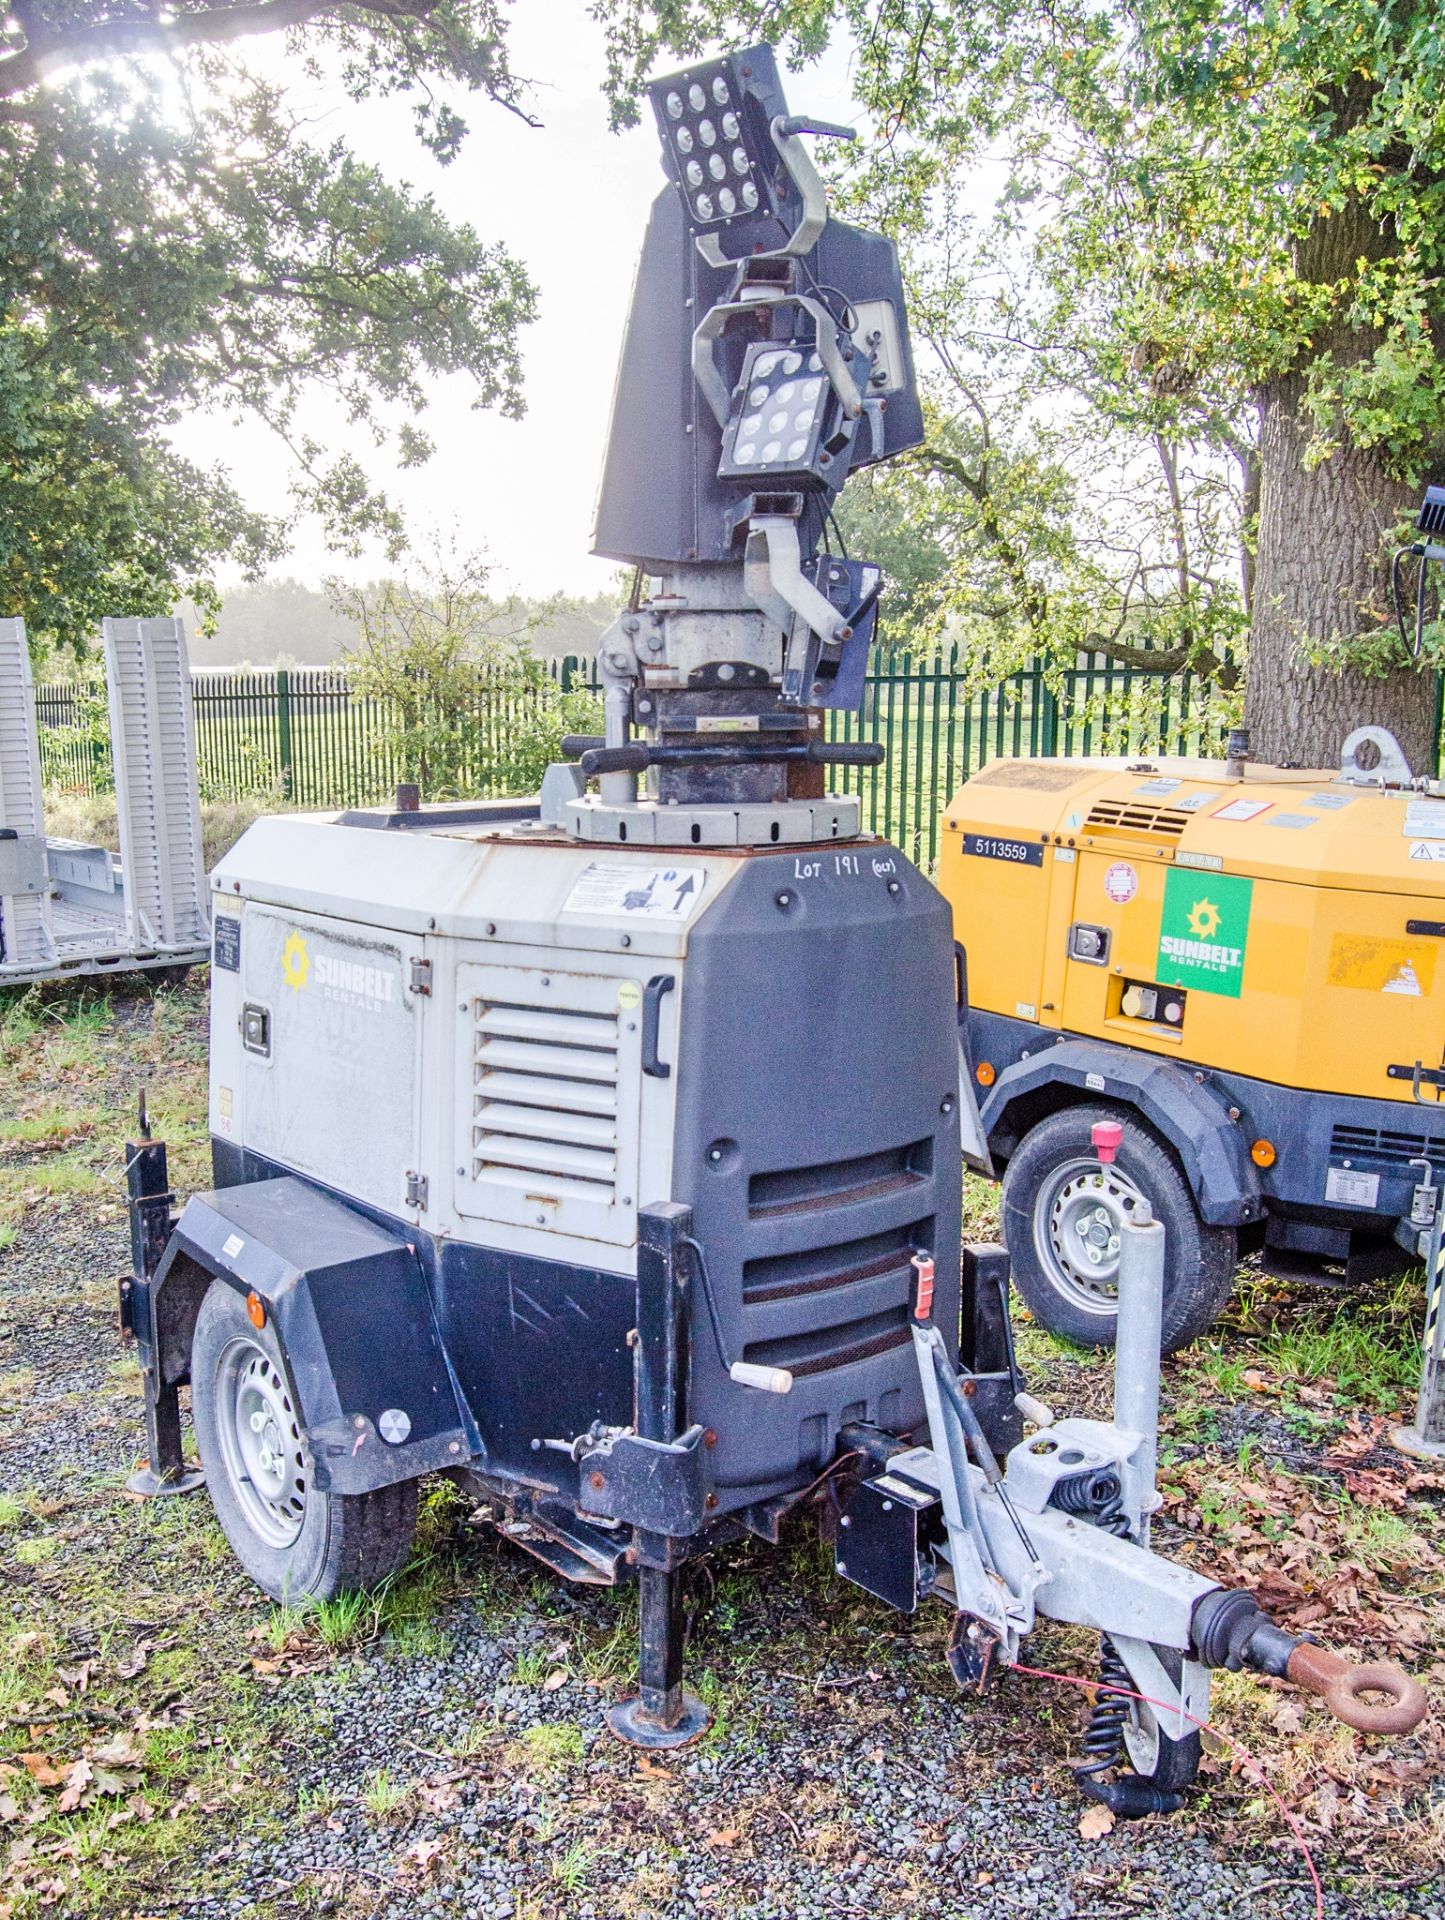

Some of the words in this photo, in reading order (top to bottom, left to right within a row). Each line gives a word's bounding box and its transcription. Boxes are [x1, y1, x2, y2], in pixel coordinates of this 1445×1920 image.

[975, 838, 1027, 861] 5113559
[794, 858, 822, 879] LOT
[835, 855, 860, 876] 191
[1160, 935, 1242, 967] SUNBELT
[1169, 954, 1227, 973] RENTALS
[314, 954, 395, 1002] SUNBELT
[323, 986, 383, 1013] RENTALS
